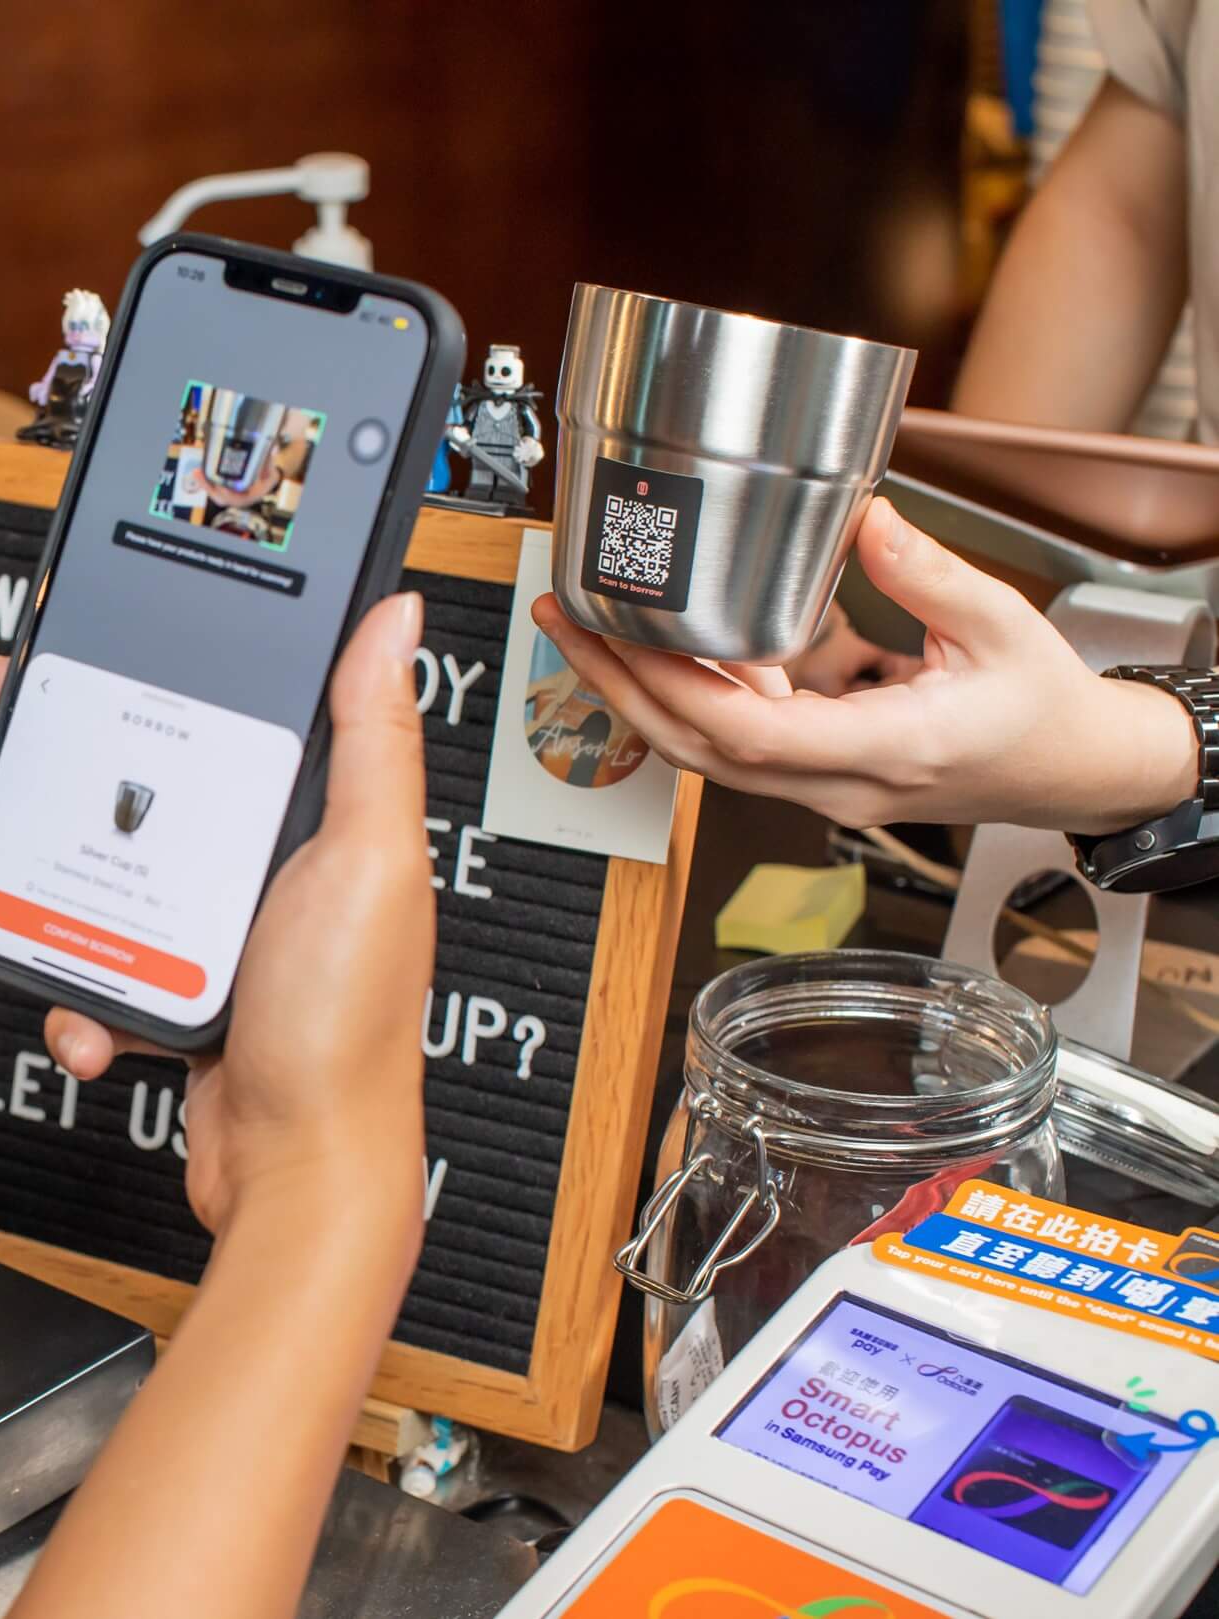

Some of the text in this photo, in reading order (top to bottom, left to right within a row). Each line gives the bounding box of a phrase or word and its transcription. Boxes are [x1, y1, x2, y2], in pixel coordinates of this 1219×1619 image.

[598, 575, 664, 597] Scan to borrow
[121, 711, 190, 741] BORROW
[960, 1188, 1161, 1265] 請在此拍卡
[887, 1244, 911, 1259] Tap
[913, 1254, 947, 1270] your
[949, 1265, 982, 1280] card
[983, 1273, 1016, 1290] here
[1019, 1284, 1052, 1301] until
[1056, 1295, 1081, 1309] the
[1138, 1319, 1186, 1339] sound
[1187, 1332, 1202, 1345] is
[850, 1327, 899, 1352] SAMSUNG
[851, 1339, 884, 1356] pay
[799, 1377, 901, 1431] Smart
[936, 1375, 978, 1397] Octopus
[765, 1420, 782, 1433] in
[781, 1426, 857, 1468] Samsung
[859, 1459, 891, 1482] Pay
[781, 1399, 908, 1465] Octopus
